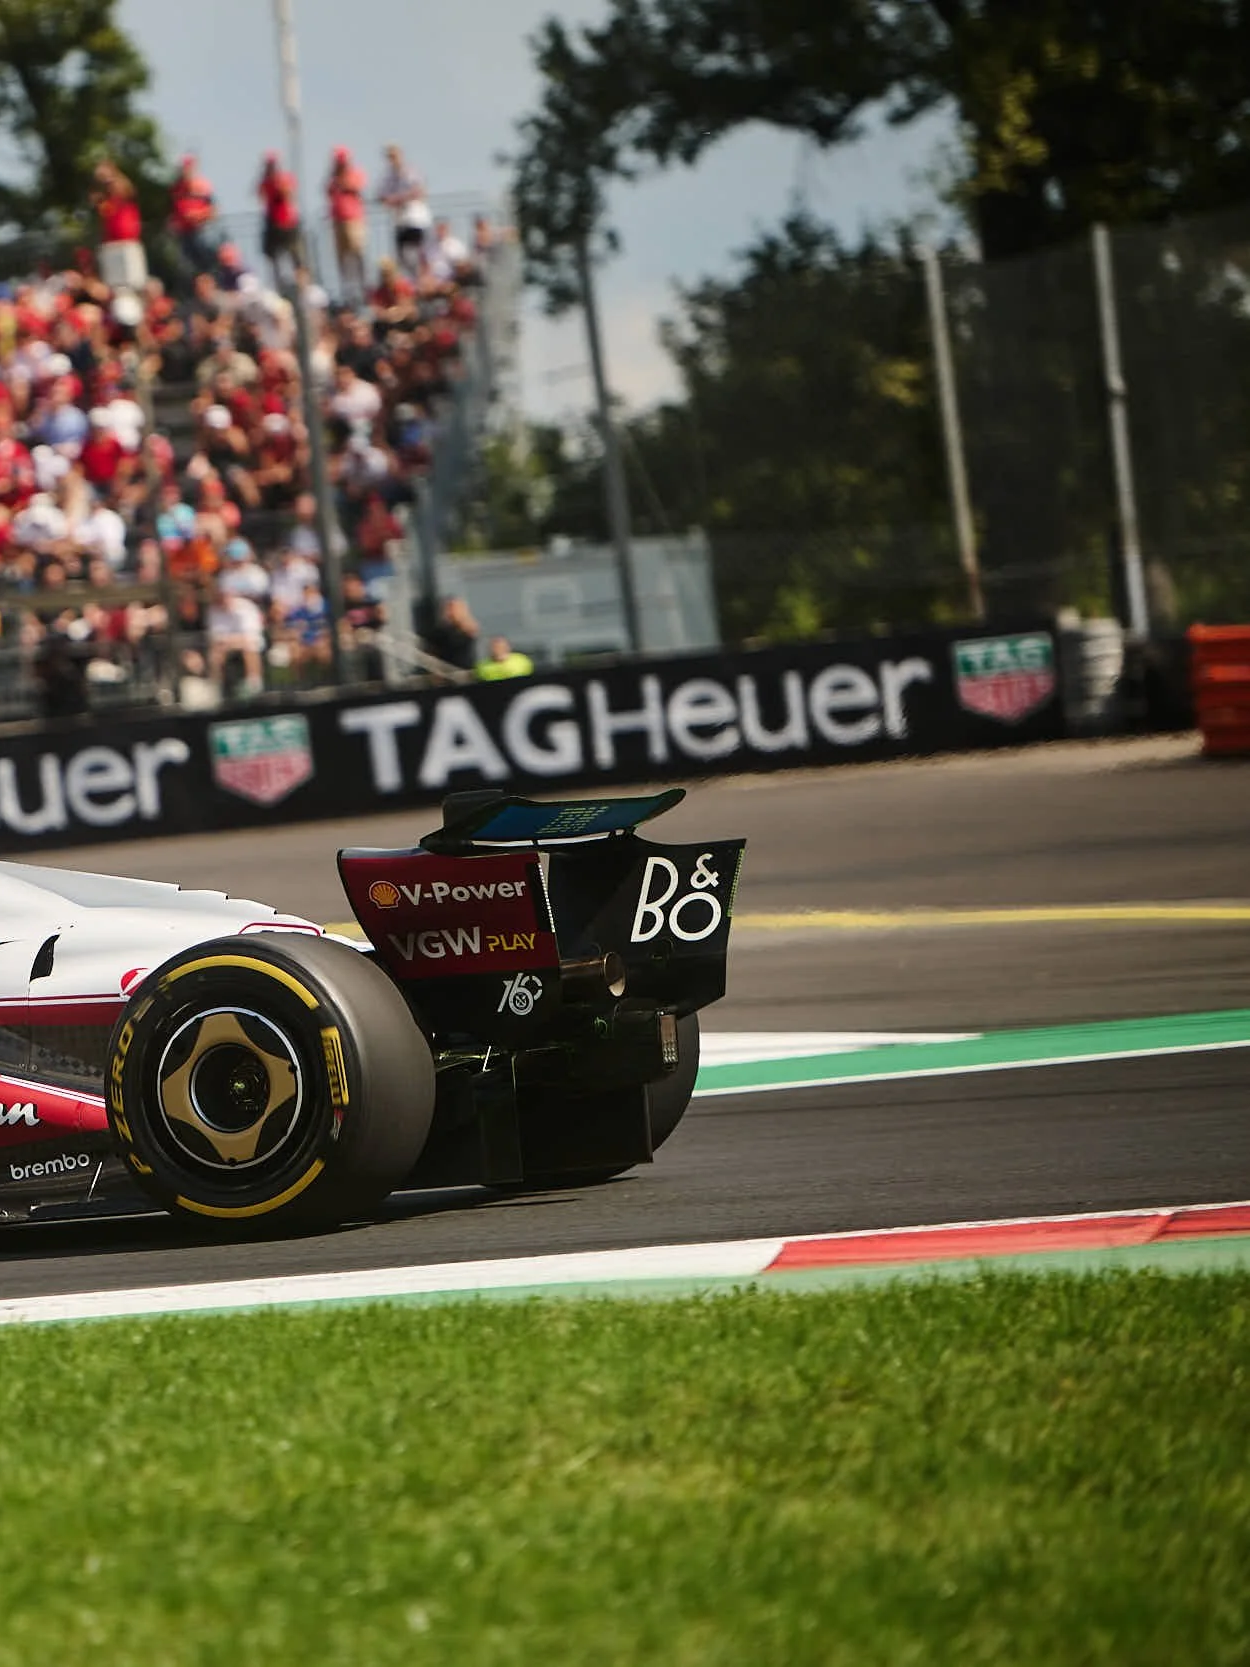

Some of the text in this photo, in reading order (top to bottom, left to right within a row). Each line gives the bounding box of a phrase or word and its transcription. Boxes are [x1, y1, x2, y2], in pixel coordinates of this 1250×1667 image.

[399, 881, 527, 906] V-Power
[387, 926, 536, 961] VGW PLAY
[110, 1019, 136, 1145] ZERO
[9, 1153, 90, 1181] brembo
